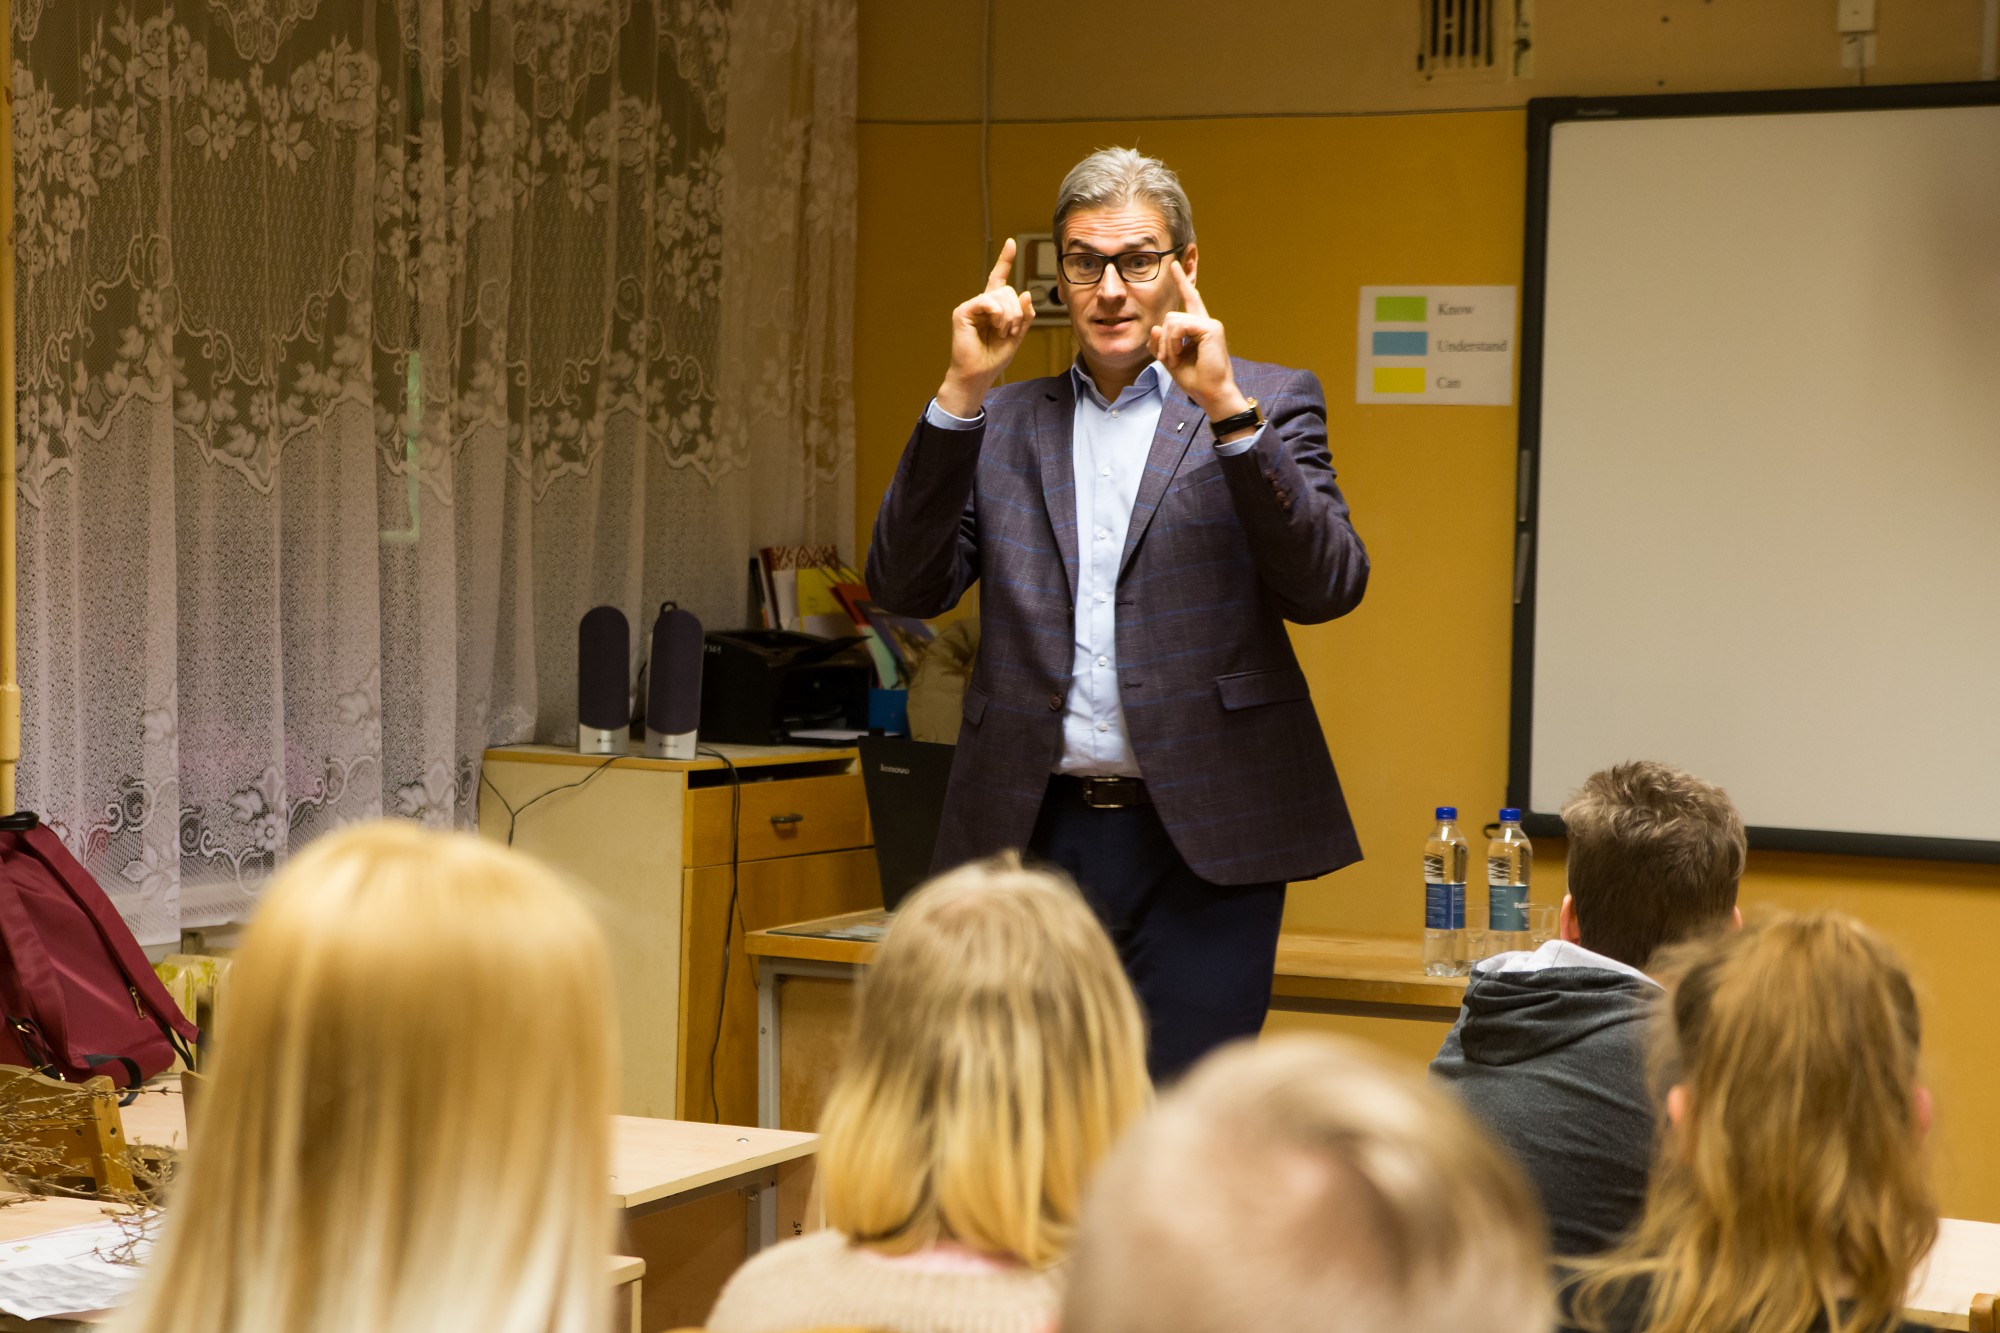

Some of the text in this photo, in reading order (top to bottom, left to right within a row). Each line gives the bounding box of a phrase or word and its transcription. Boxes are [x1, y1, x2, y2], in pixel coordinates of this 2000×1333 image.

[1438, 303, 1474, 315] Know
[1437, 340, 1508, 352] Understand
[1436, 377, 1461, 389] Can
